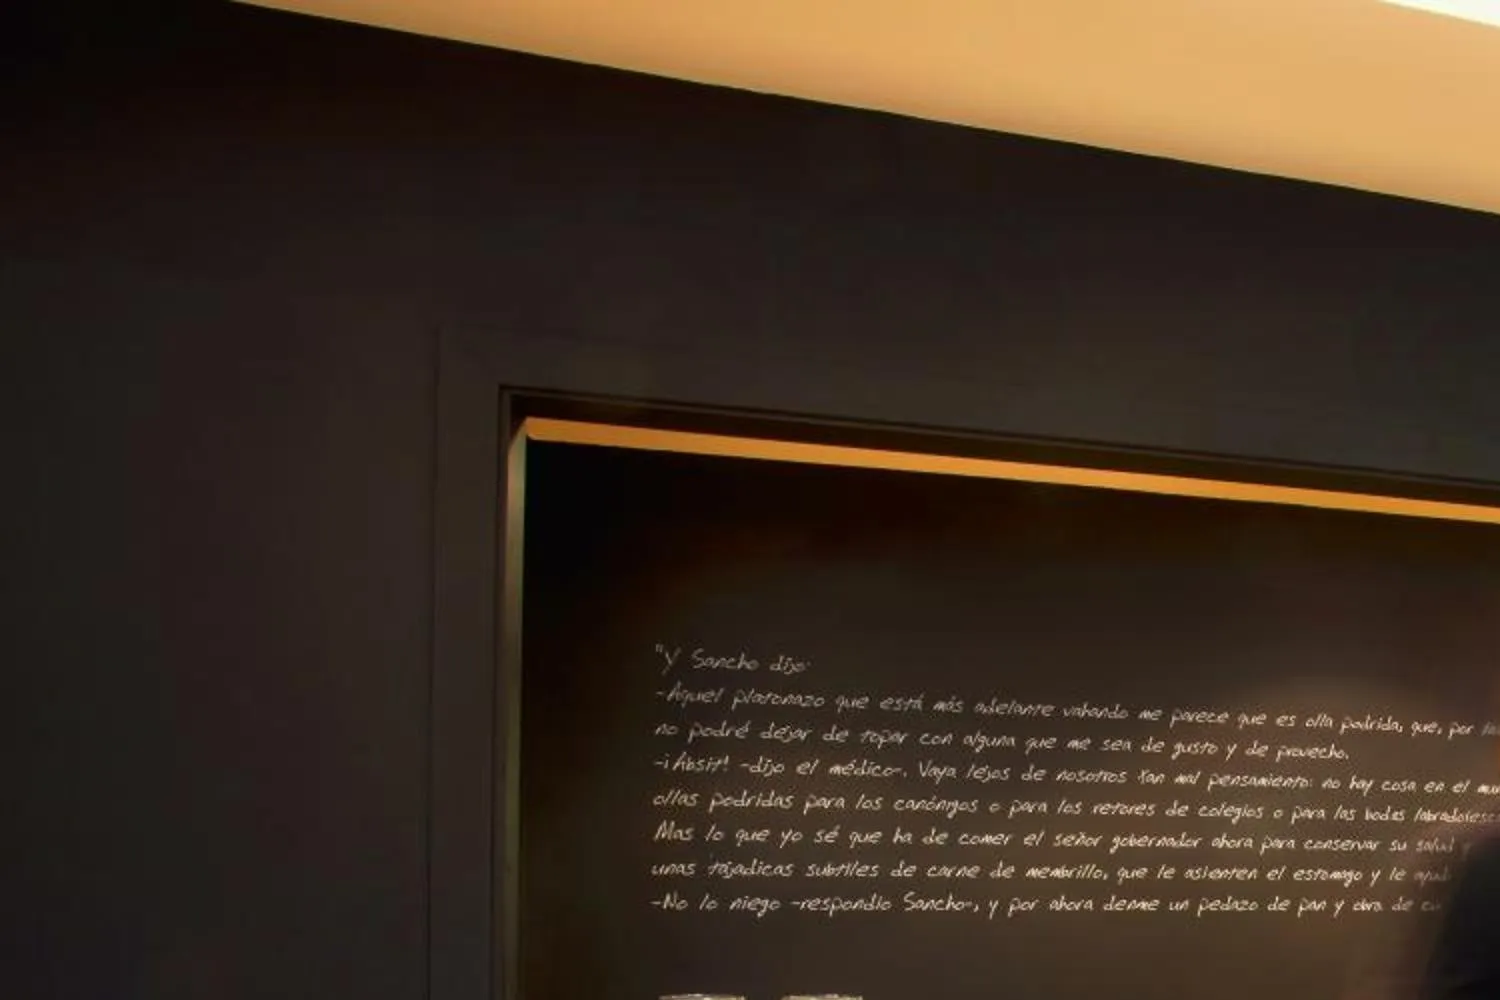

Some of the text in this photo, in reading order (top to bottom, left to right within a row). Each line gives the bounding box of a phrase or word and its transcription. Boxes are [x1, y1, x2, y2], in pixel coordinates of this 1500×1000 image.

[655, 643, 681, 676] "Y
[691, 648, 761, 670] Sancho
[835, 696, 870, 713] que
[974, 698, 1056, 716] adelante
[1138, 710, 1163, 720] me
[1169, 710, 1230, 728] parece
[1237, 713, 1267, 729] que
[1275, 715, 1297, 726] es
[1305, 714, 1333, 728] olla
[1447, 722, 1475, 740] por
[654, 723, 678, 735] no
[760, 722, 813, 742] dejar
[822, 724, 849, 742] de
[860, 730, 908, 749] topar
[919, 733, 953, 745] con
[963, 731, 1016, 753] alguna
[1025, 737, 1058, 754] que
[1066, 738, 1092, 750] me
[1102, 739, 1132, 752] sea
[1140, 736, 1165, 752] de
[1171, 742, 1219, 760] gusto
[1225, 744, 1238, 760] y
[1245, 740, 1269, 757] de
[795, 759, 820, 775] el
[1021, 765, 1047, 781] de
[1055, 770, 1129, 783] nosotros
[1137, 770, 1166, 784] tan
[1174, 771, 1201, 784] mal
[1321, 778, 1341, 788] no
[1348, 775, 1374, 796] hay
[1381, 780, 1417, 792] cosa
[1423, 781, 1445, 792] en
[1452, 780, 1471, 793] el
[652, 790, 699, 806] ollas
[708, 790, 795, 813] podridas
[803, 795, 846, 815] para
[855, 794, 884, 810] los
[988, 803, 1000, 812] o
[1008, 800, 1048, 818] para
[1057, 800, 1083, 814] los
[1092, 803, 1156, 816] retores
[1165, 800, 1189, 816] de
[1198, 802, 1264, 824] colegios
[1273, 810, 1283, 818] o
[1290, 806, 1326, 824] para
[1333, 805, 1357, 820] las
[1364, 806, 1405, 821] bodas
[653, 820, 695, 841] Mas
[704, 824, 725, 841] lo
[735, 829, 771, 846] que
[780, 829, 803, 848] yo
[849, 832, 883, 848] que
[892, 827, 913, 844] ha
[922, 828, 949, 845] de
[958, 834, 1012, 845] comer
[1023, 831, 1045, 846] el
[1053, 832, 1103, 847] señor
[1109, 832, 1203, 854] gobernador
[1211, 833, 1253, 848] ahora
[1259, 835, 1296, 855] para
[1303, 840, 1381, 851] conservar
[1389, 840, 1408, 851] su
[651, 863, 697, 876] unas
[707, 859, 794, 879] tajadicas
[890, 860, 917, 877] de
[926, 866, 981, 878] carne
[989, 860, 1015, 878] de
[1117, 867, 1148, 884] que
[1156, 864, 1176, 879] le
[1183, 866, 1258, 880] asienten
[1266, 866, 1287, 880] el
[1371, 870, 1381, 887] y
[1389, 867, 1407, 880] le
[698, 894, 719, 911] lo
[729, 896, 781, 918] niego
[988, 900, 999, 920] y
[1007, 897, 1039, 917] por
[1049, 896, 1094, 911] ahora
[1102, 896, 1161, 911] denme
[1168, 900, 1190, 911] un
[1196, 896, 1259, 917] pedazo
[1267, 896, 1291, 911] de
[1297, 898, 1327, 917] pan
[1333, 900, 1345, 918] y
[1352, 899, 1383, 912] obra
[1391, 896, 1414, 911] de
